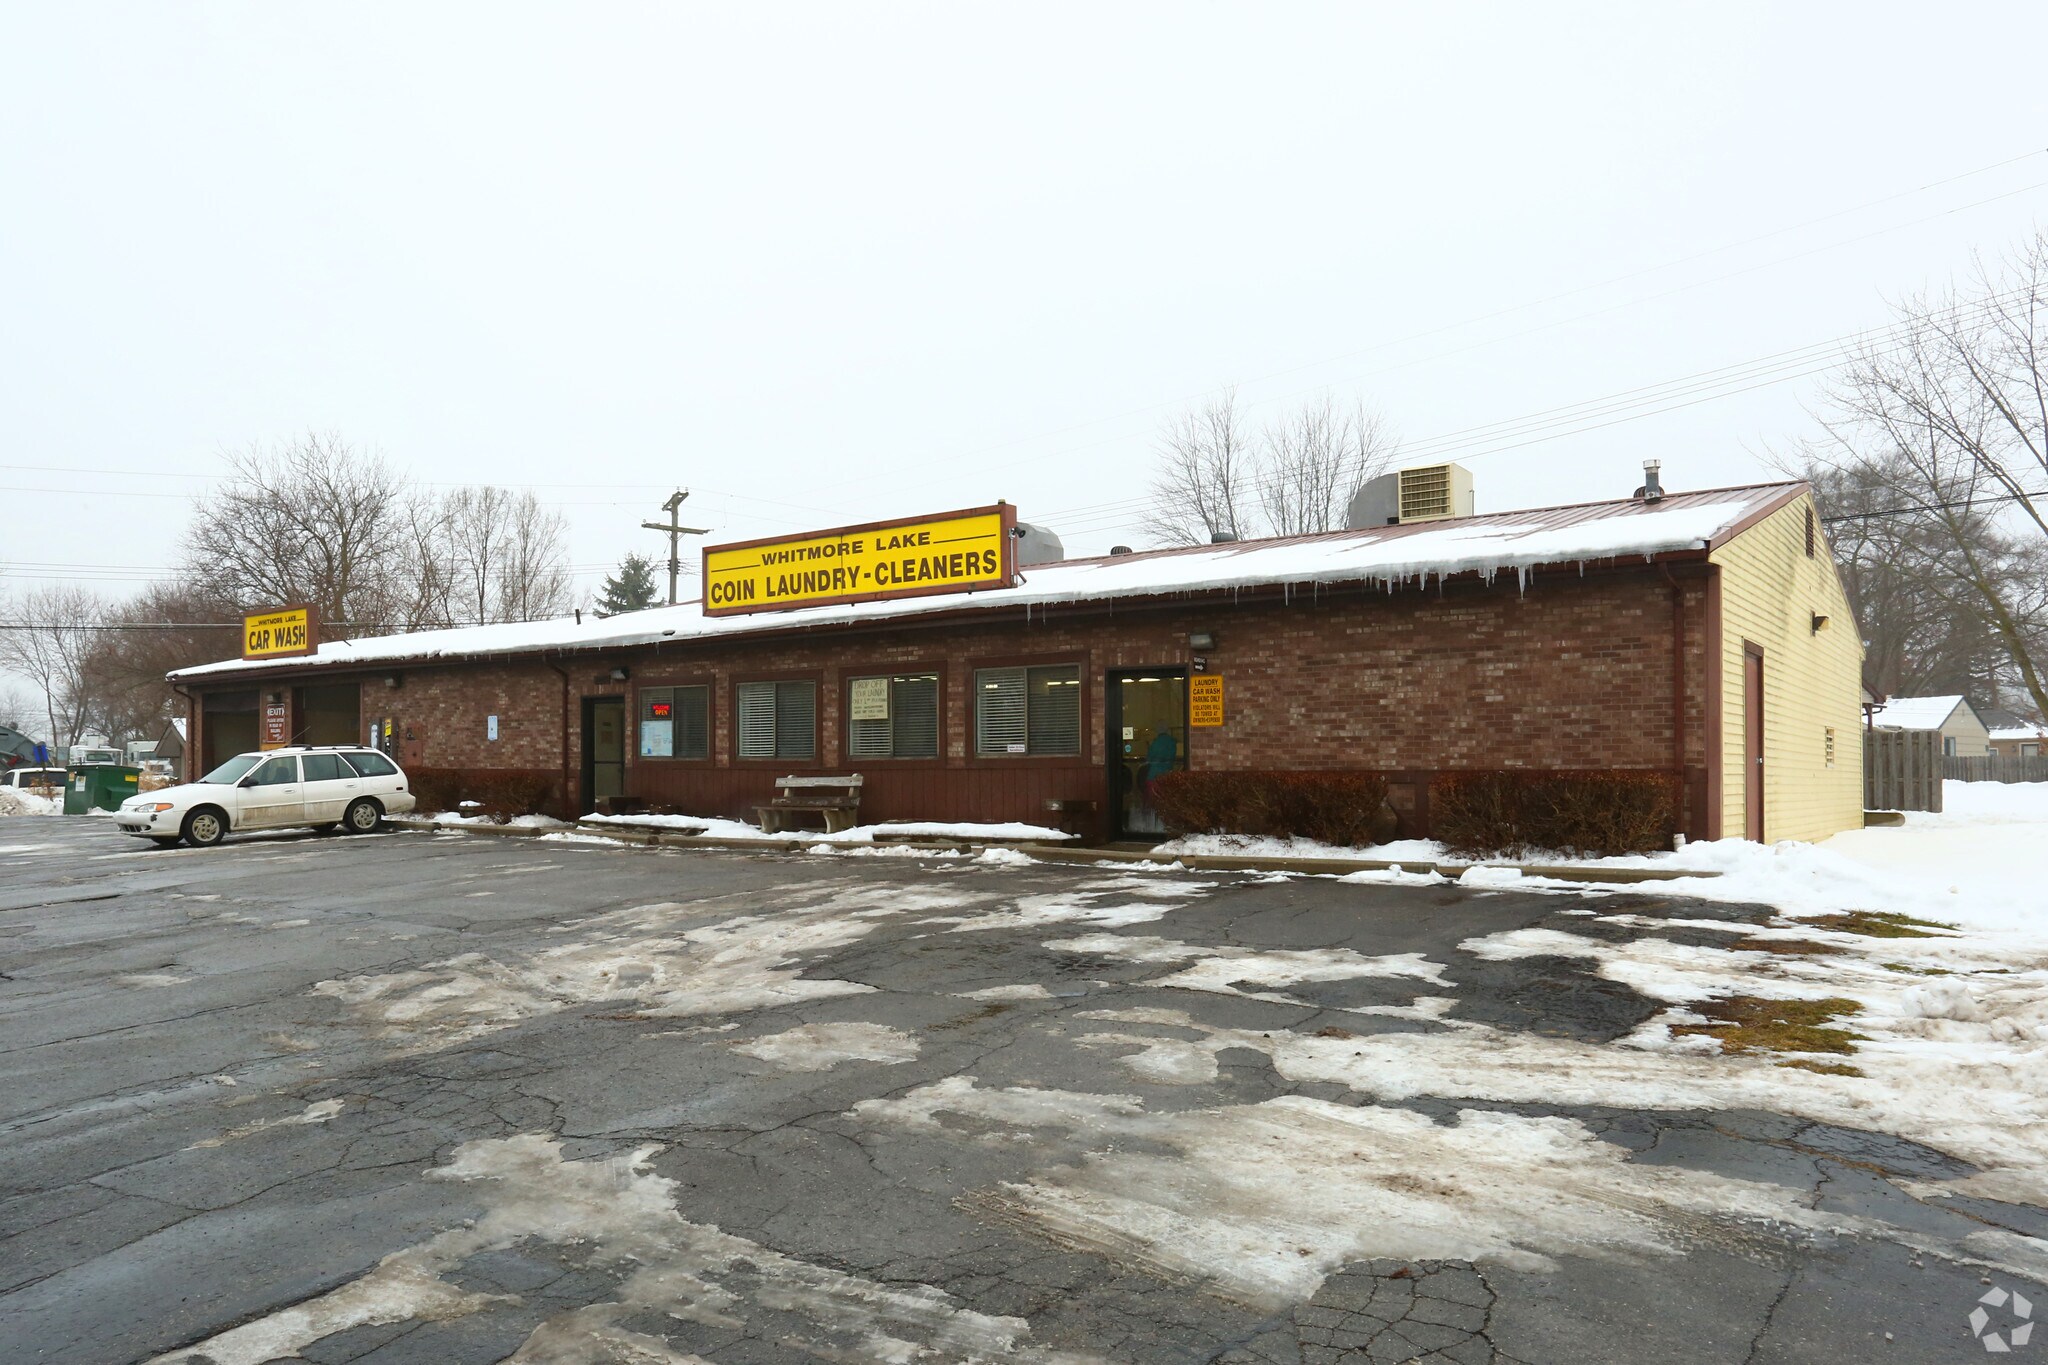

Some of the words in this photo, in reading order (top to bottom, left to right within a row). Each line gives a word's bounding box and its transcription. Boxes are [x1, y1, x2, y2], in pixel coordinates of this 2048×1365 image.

[761, 540, 864, 566] WHITMORE
[876, 531, 931, 551] LAKE
[711, 578, 755, 604] COIN
[258, 617, 283, 626] WHITMORE
[249, 629, 270, 651] CAR
[274, 625, 306, 648] WASH
[1192, 695, 1210, 703] PARKING
[268, 707, 284, 716] EXIT
